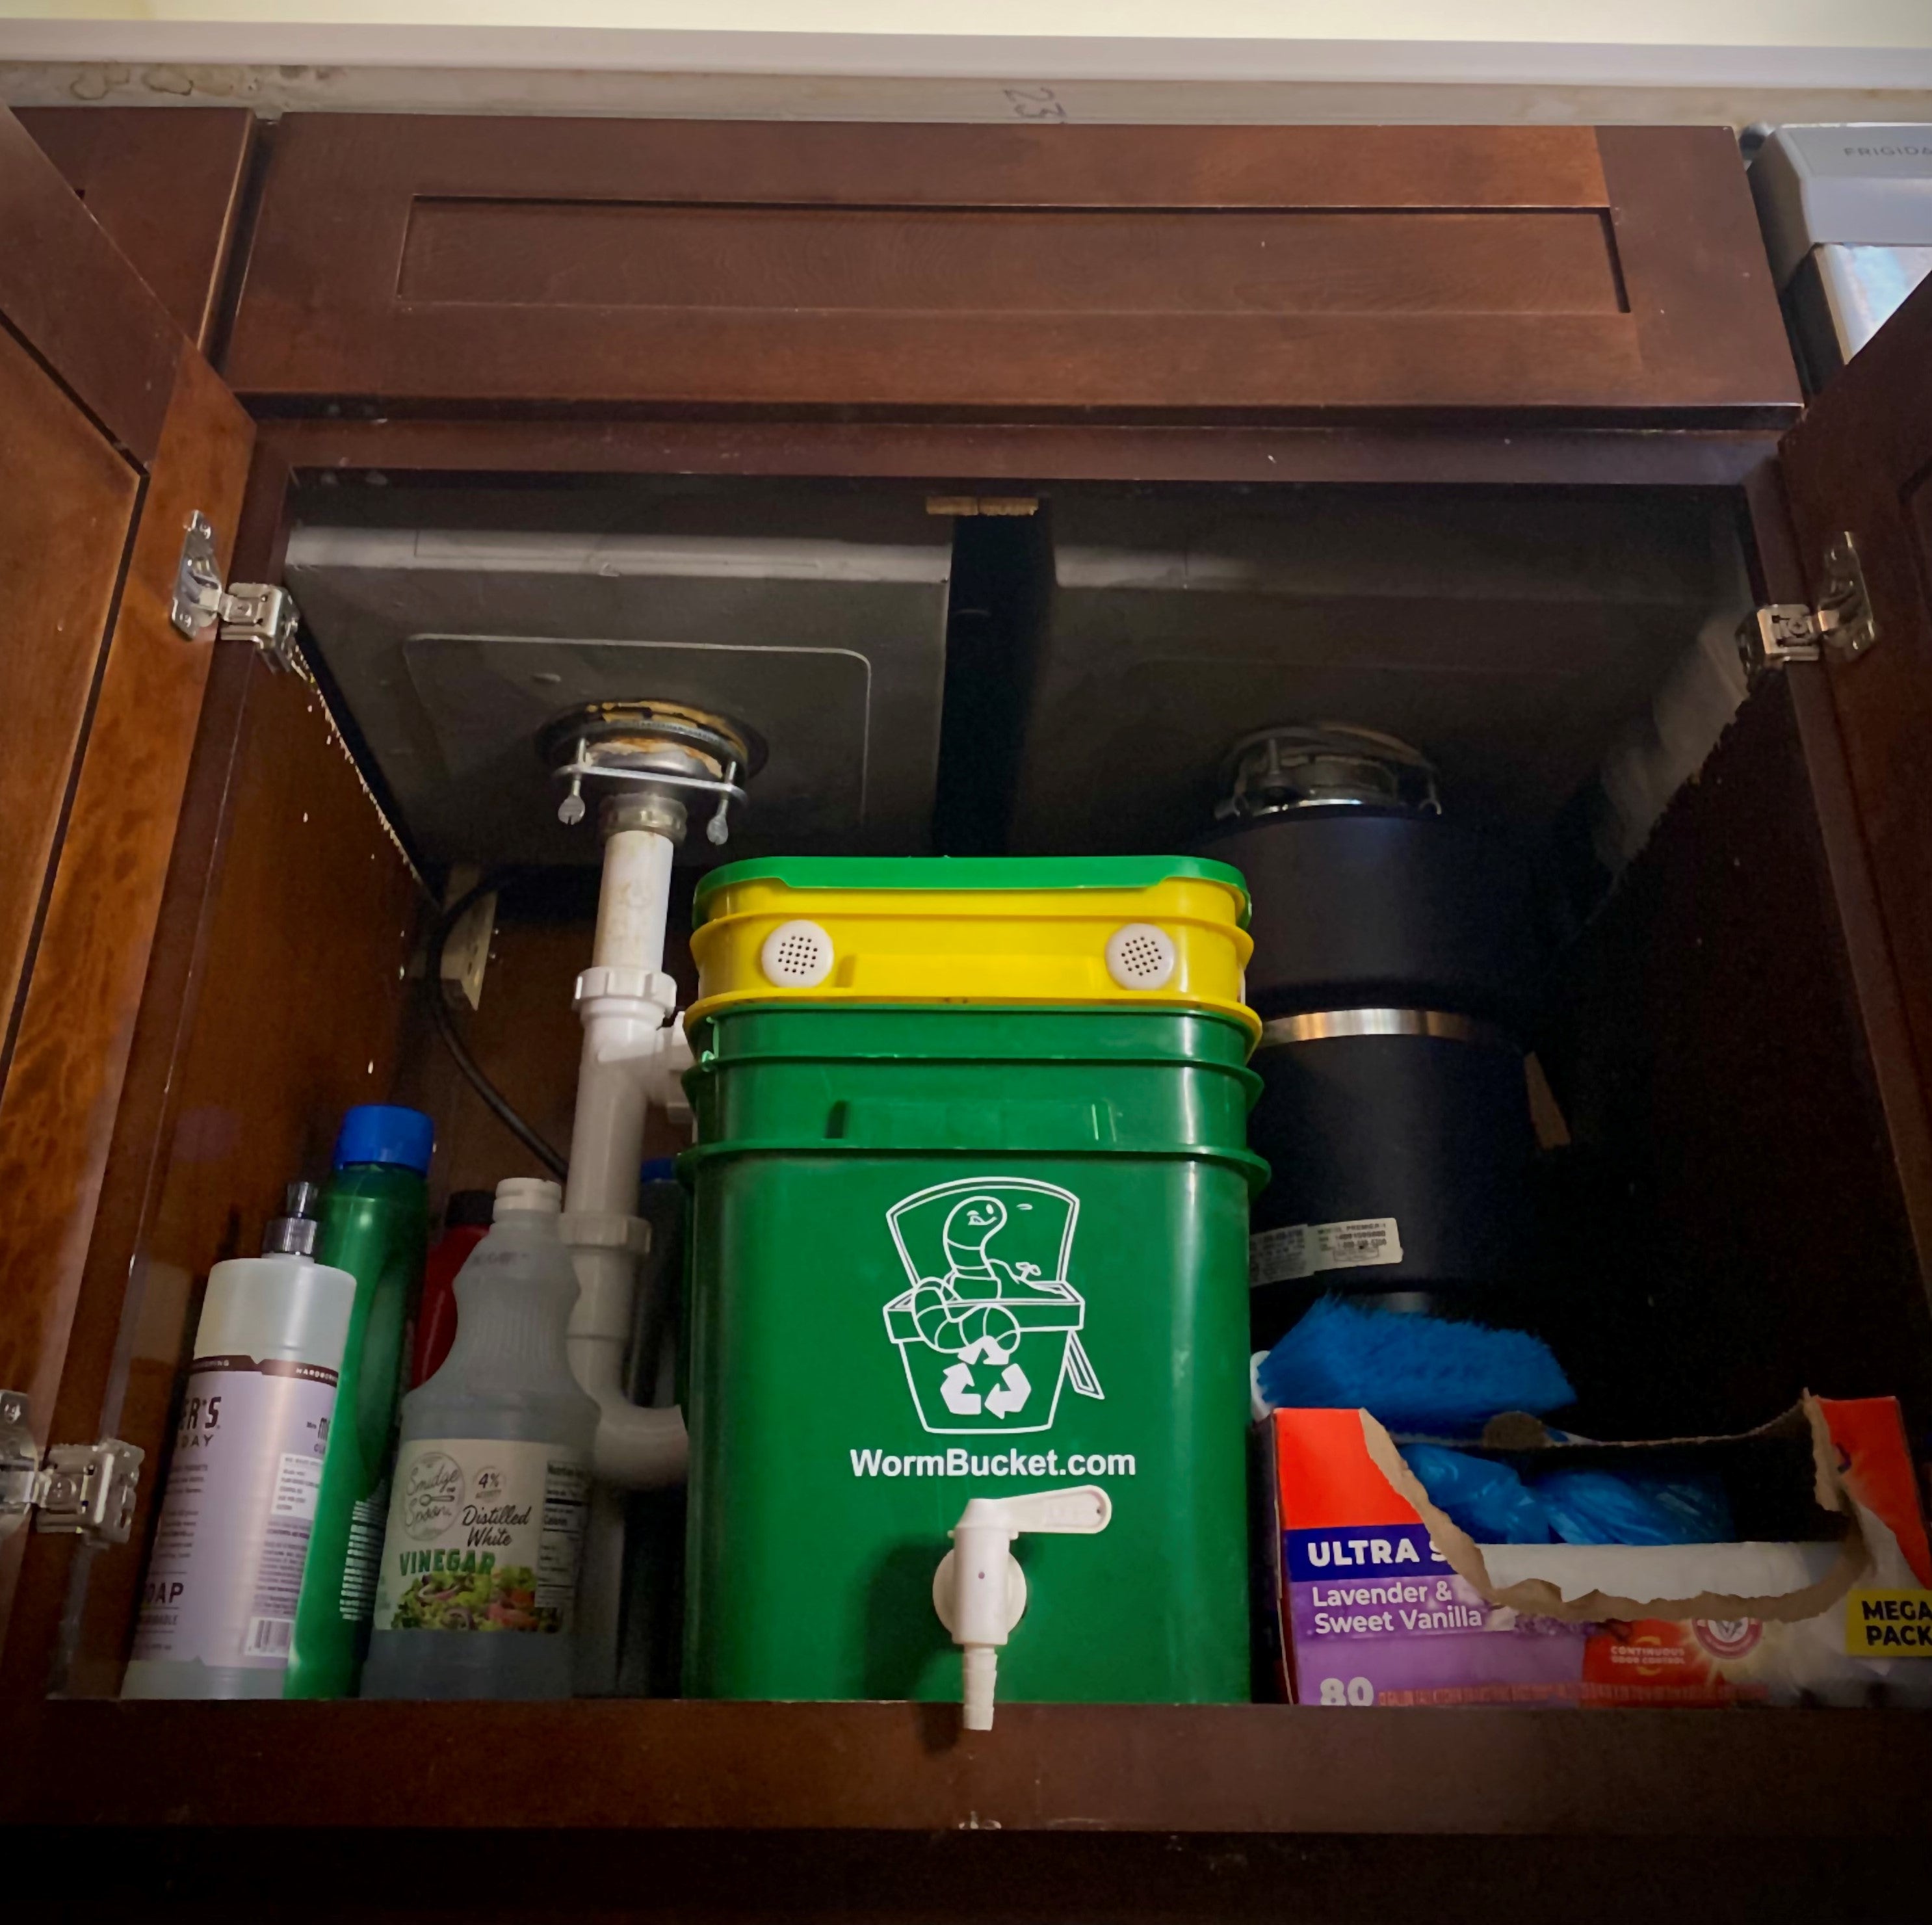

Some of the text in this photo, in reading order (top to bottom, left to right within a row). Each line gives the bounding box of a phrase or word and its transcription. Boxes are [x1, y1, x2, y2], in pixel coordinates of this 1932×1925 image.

[850, 1448, 1136, 1476] WormBucket.com
[478, 1473, 500, 1489] 4%
[462, 1505, 532, 1526] Distilled
[467, 1527, 512, 1547] White
[400, 1549, 495, 1577] VINEGAR
[1308, 1538, 1420, 1567] ULTRA
[1312, 1581, 1452, 1606] Lavender &
[1314, 1605, 1483, 1634] Sweet Vanilla
[1862, 1601, 1932, 1620] MEGA
[1866, 1625, 1932, 1645] PACK
[1610, 1645, 1685, 1656] CONTINUOUS
[1320, 1677, 1374, 1707] 80
